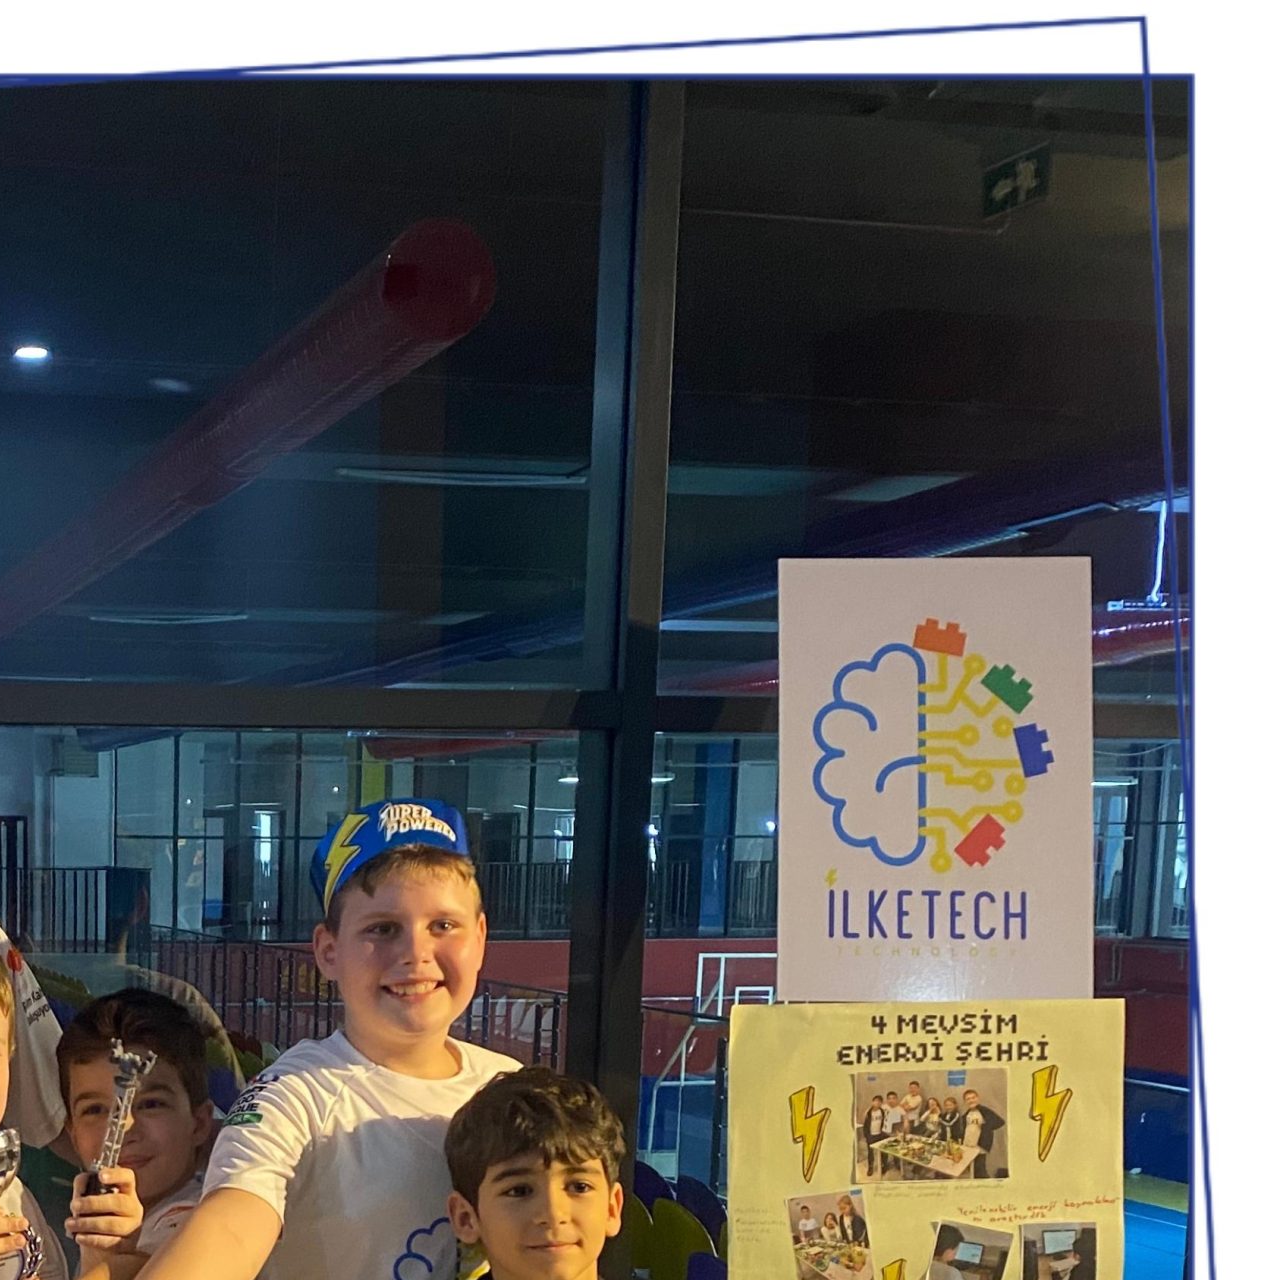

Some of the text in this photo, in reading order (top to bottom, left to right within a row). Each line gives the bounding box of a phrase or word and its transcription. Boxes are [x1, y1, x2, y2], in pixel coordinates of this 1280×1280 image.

[385, 817, 457, 842] POWERED
[871, 1009, 1018, 1035] 4 MEVSİM
[837, 1034, 1050, 1065] ENERJİ ŞEHRİ
